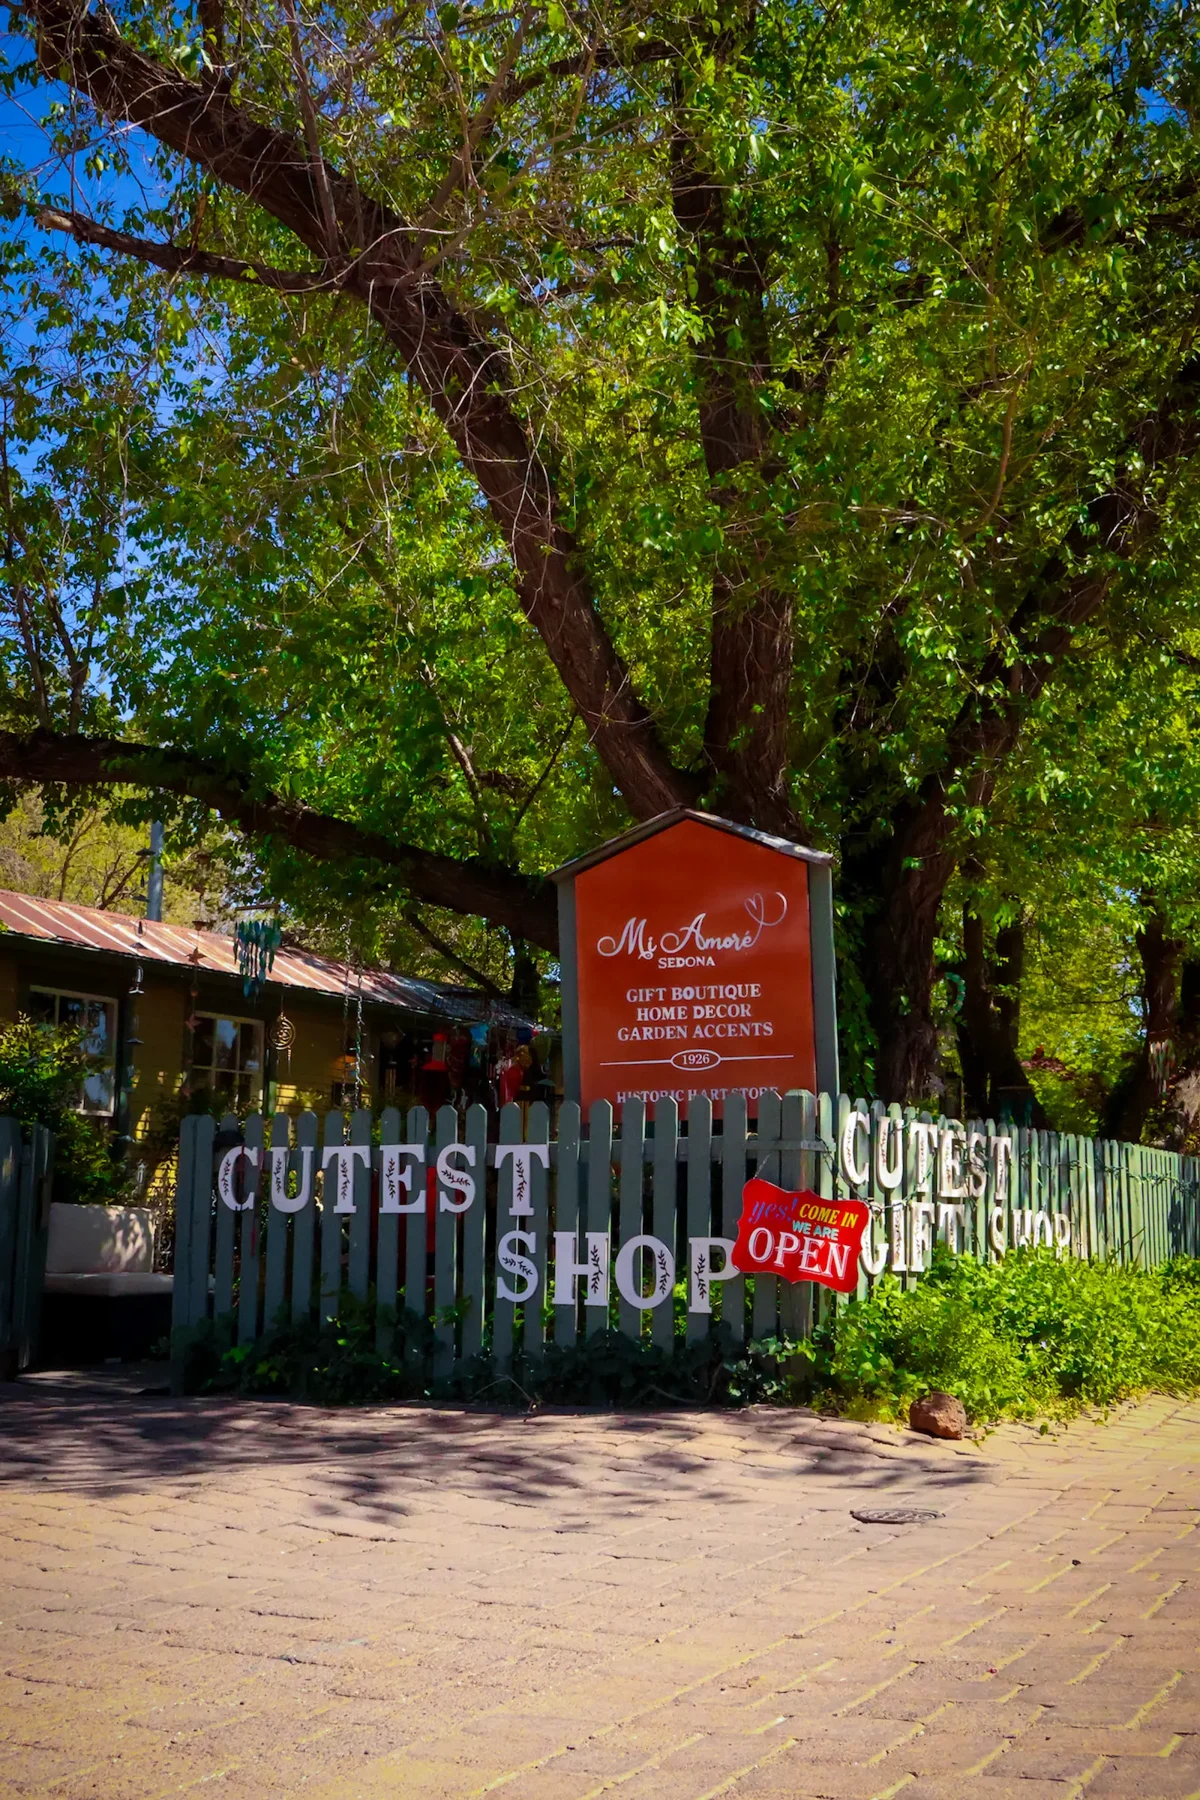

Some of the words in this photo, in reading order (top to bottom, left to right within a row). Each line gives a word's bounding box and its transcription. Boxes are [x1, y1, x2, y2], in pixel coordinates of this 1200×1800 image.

[597, 917, 657, 959] Mi
[660, 913, 756, 954] Amoré
[658, 956, 715, 968] SEDONA
[626, 987, 666, 1002] GIFT
[671, 983, 761, 1001] BOUTIQUE
[637, 1006, 687, 1021] HOME
[693, 1003, 751, 1019] DECOR
[617, 1026, 688, 1041] GARDEN
[693, 1021, 773, 1038] ACCENTS
[682, 1053, 710, 1065] 1926
[842, 1112, 1012, 1200] CUTEST
[218, 1143, 549, 1216] CUTEST
[748, 1197, 798, 1224] yes!
[799, 1203, 840, 1225] COME
[840, 1212, 859, 1229] IN
[792, 1220, 812, 1235] WE
[813, 1228, 839, 1241] ARE
[748, 1227, 851, 1280] OPEN
[497, 1230, 741, 1314] SHOP
